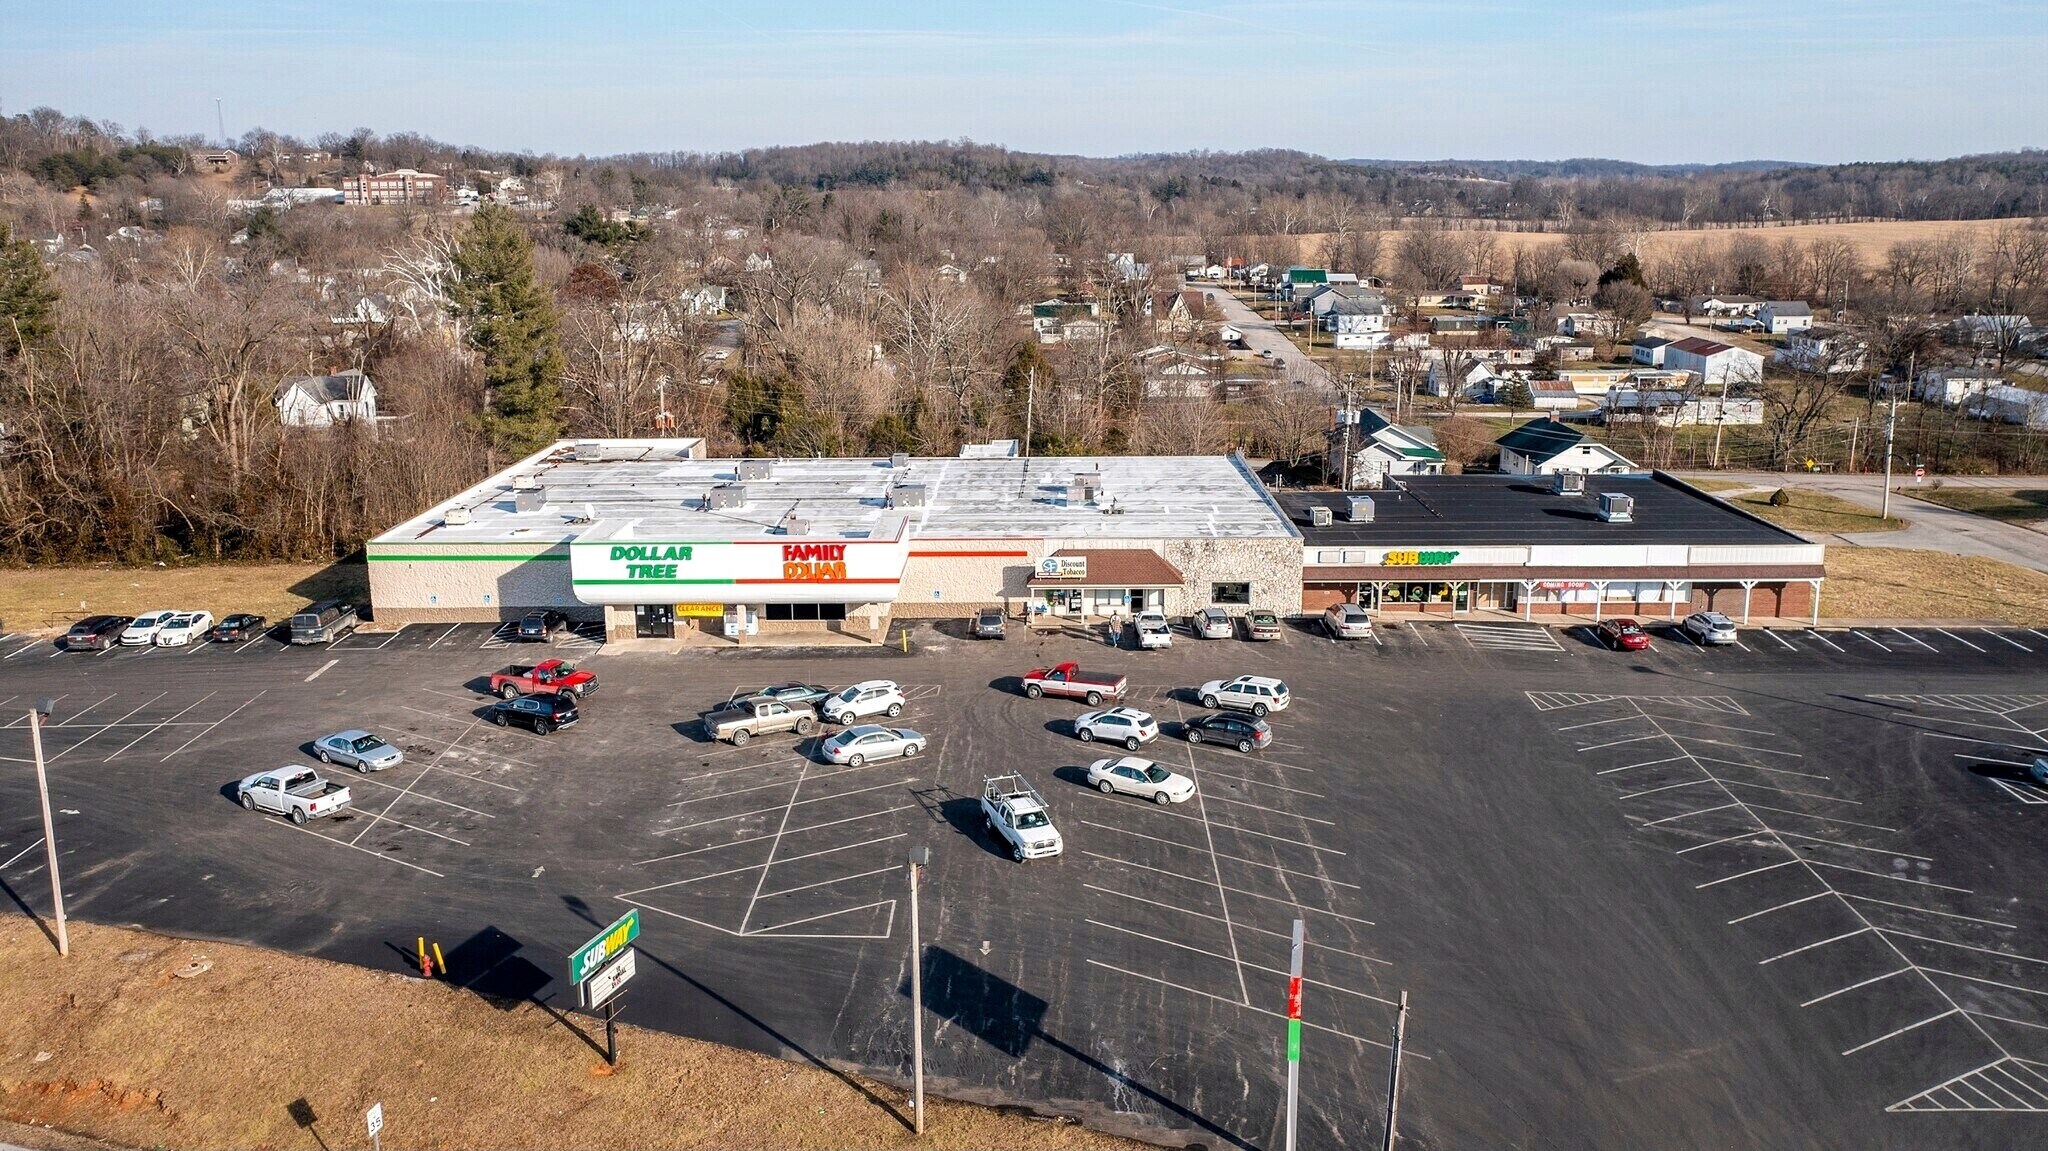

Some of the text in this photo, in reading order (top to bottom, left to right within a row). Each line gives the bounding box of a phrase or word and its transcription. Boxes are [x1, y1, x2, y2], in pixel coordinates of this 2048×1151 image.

[610, 546, 693, 561] DOLLAR
[782, 545, 847, 561] FAMILY
[1379, 551, 1460, 567] SUBWAY
[626, 564, 678, 579] TREE
[783, 561, 847, 581] DOLLAR
[1063, 568, 1086, 576] Tobacco
[579, 916, 635, 976] SUBWAY
